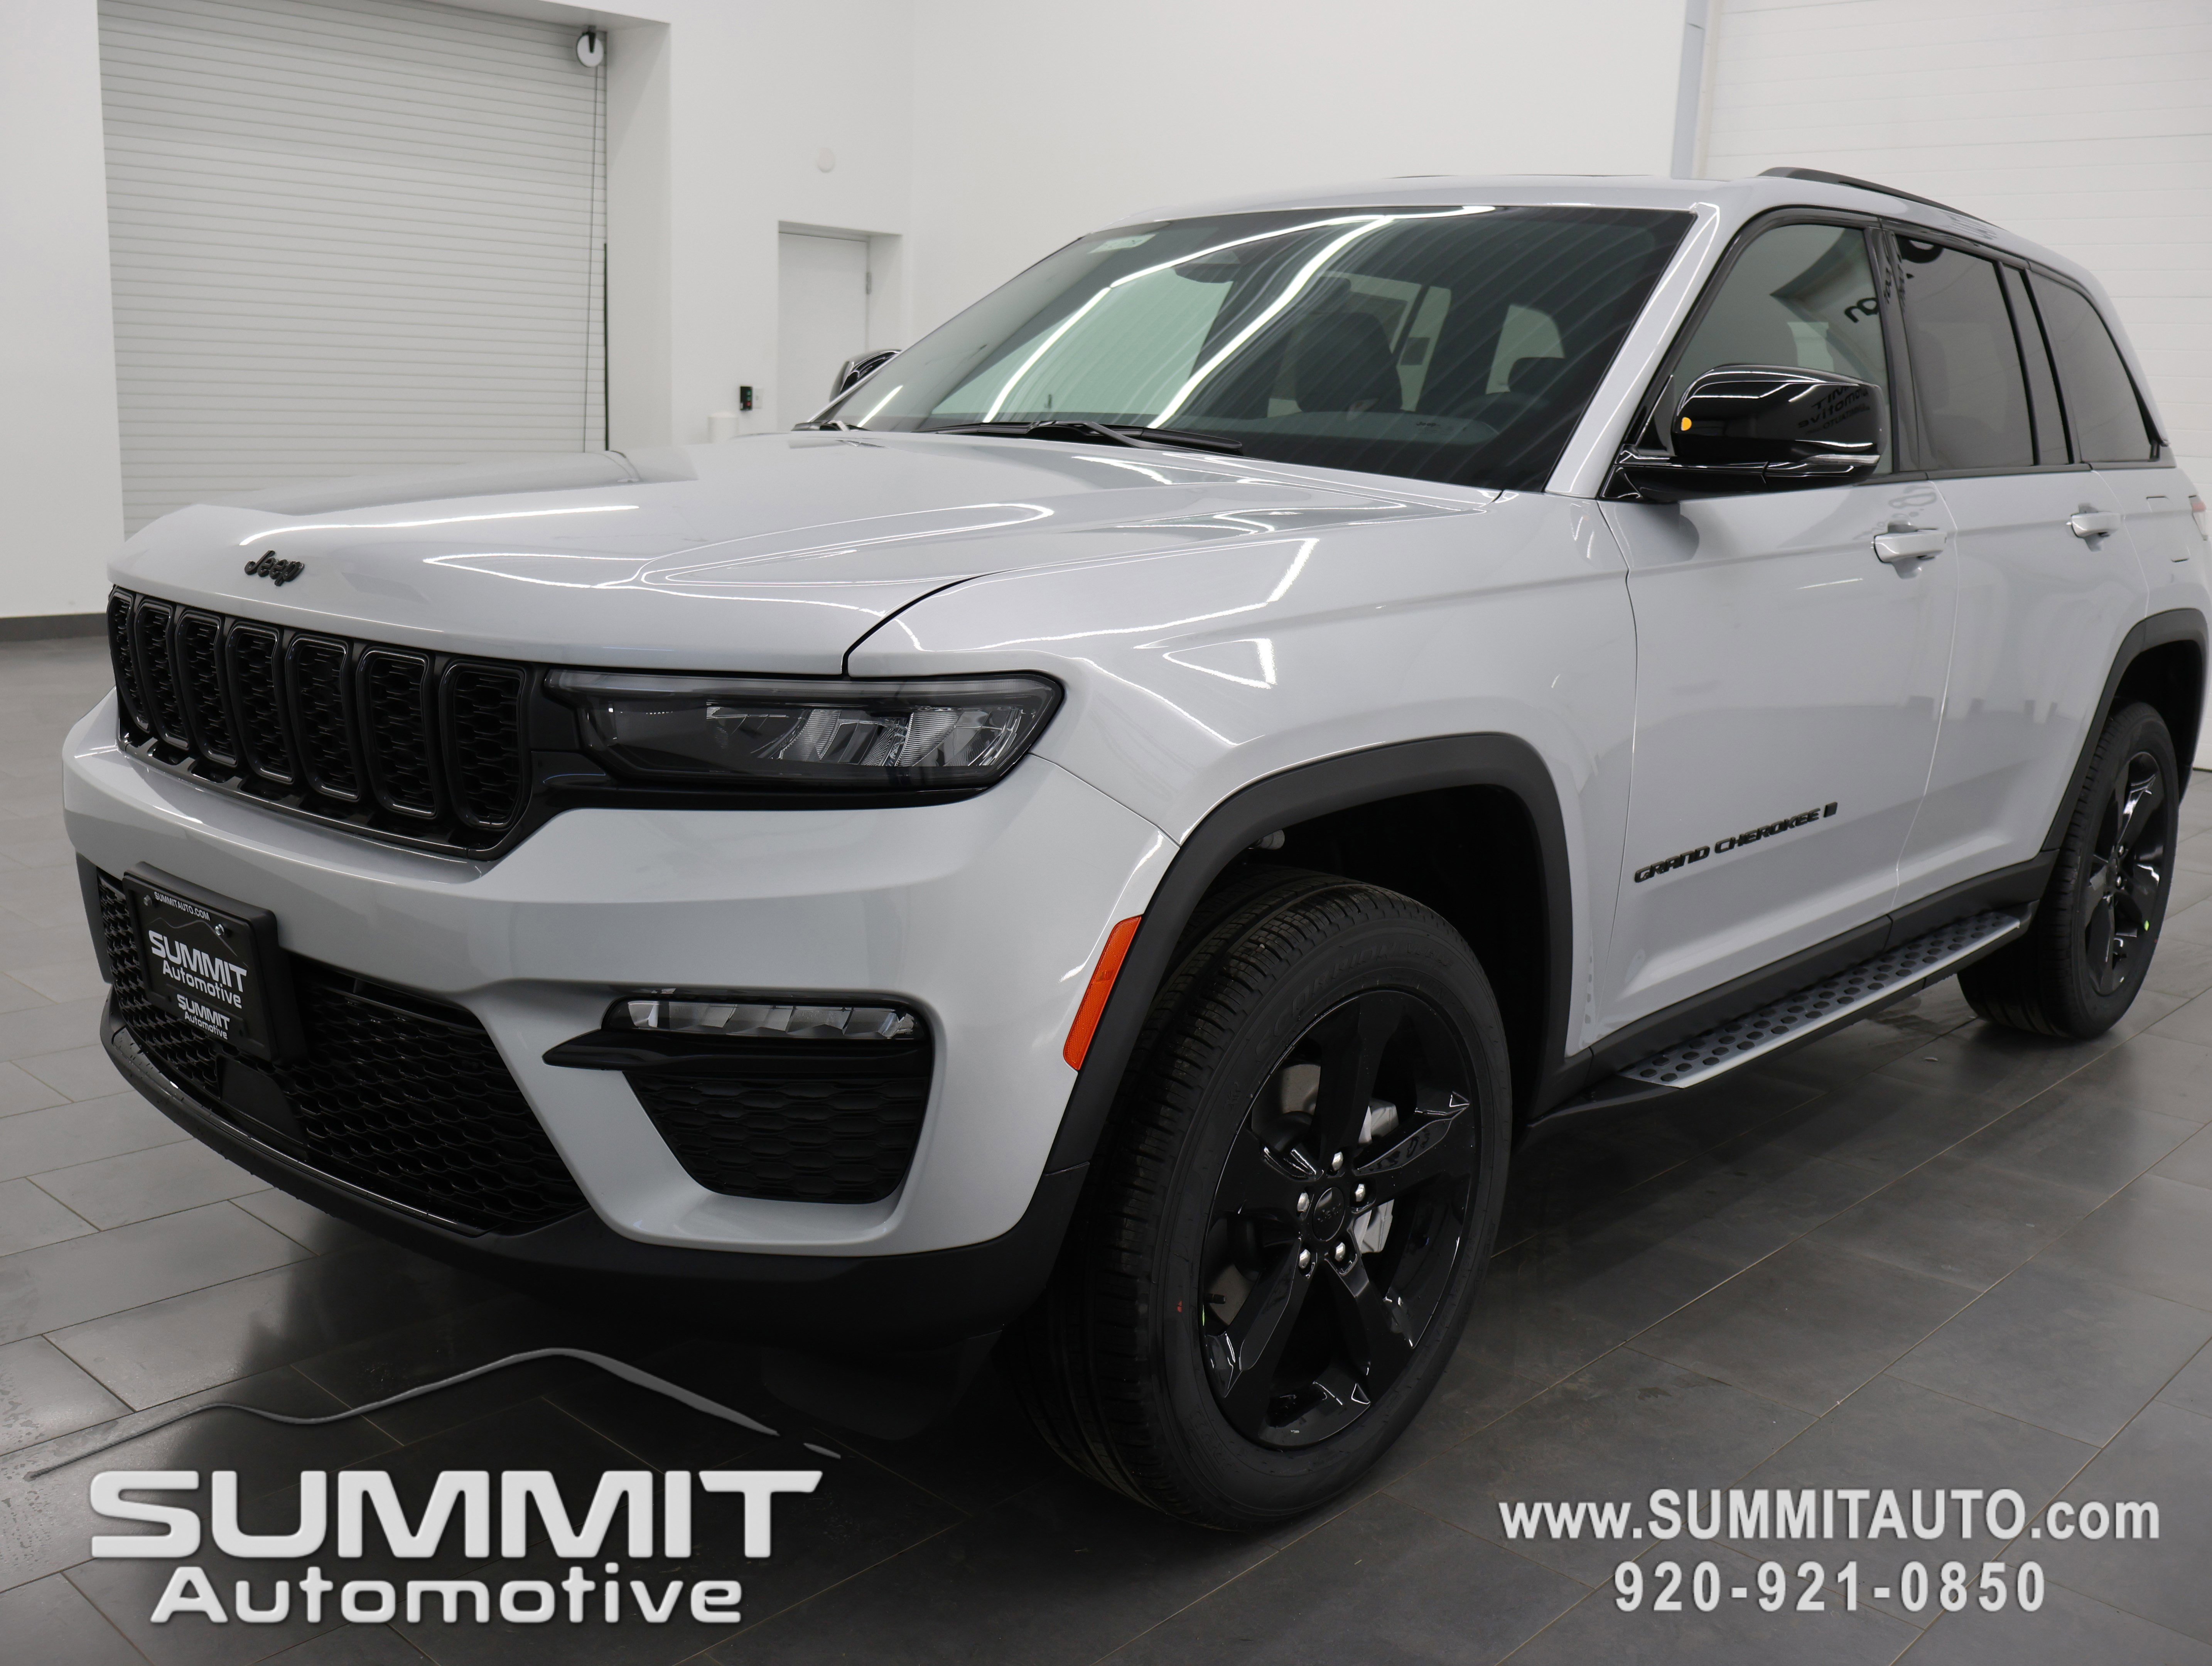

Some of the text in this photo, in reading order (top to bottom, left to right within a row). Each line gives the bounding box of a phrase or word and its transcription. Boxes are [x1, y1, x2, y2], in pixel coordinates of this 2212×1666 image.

[244, 550, 305, 587] Jeep
[1634, 808, 1821, 883] GRAND CHEROKEE
[154, 891, 210, 921] SUMMITAUTO.COM
[148, 930, 247, 992] SUMMIT
[163, 959, 242, 1009] Automotive
[177, 994, 230, 1030] SUMMIT
[184, 1012, 228, 1040] Automotive
